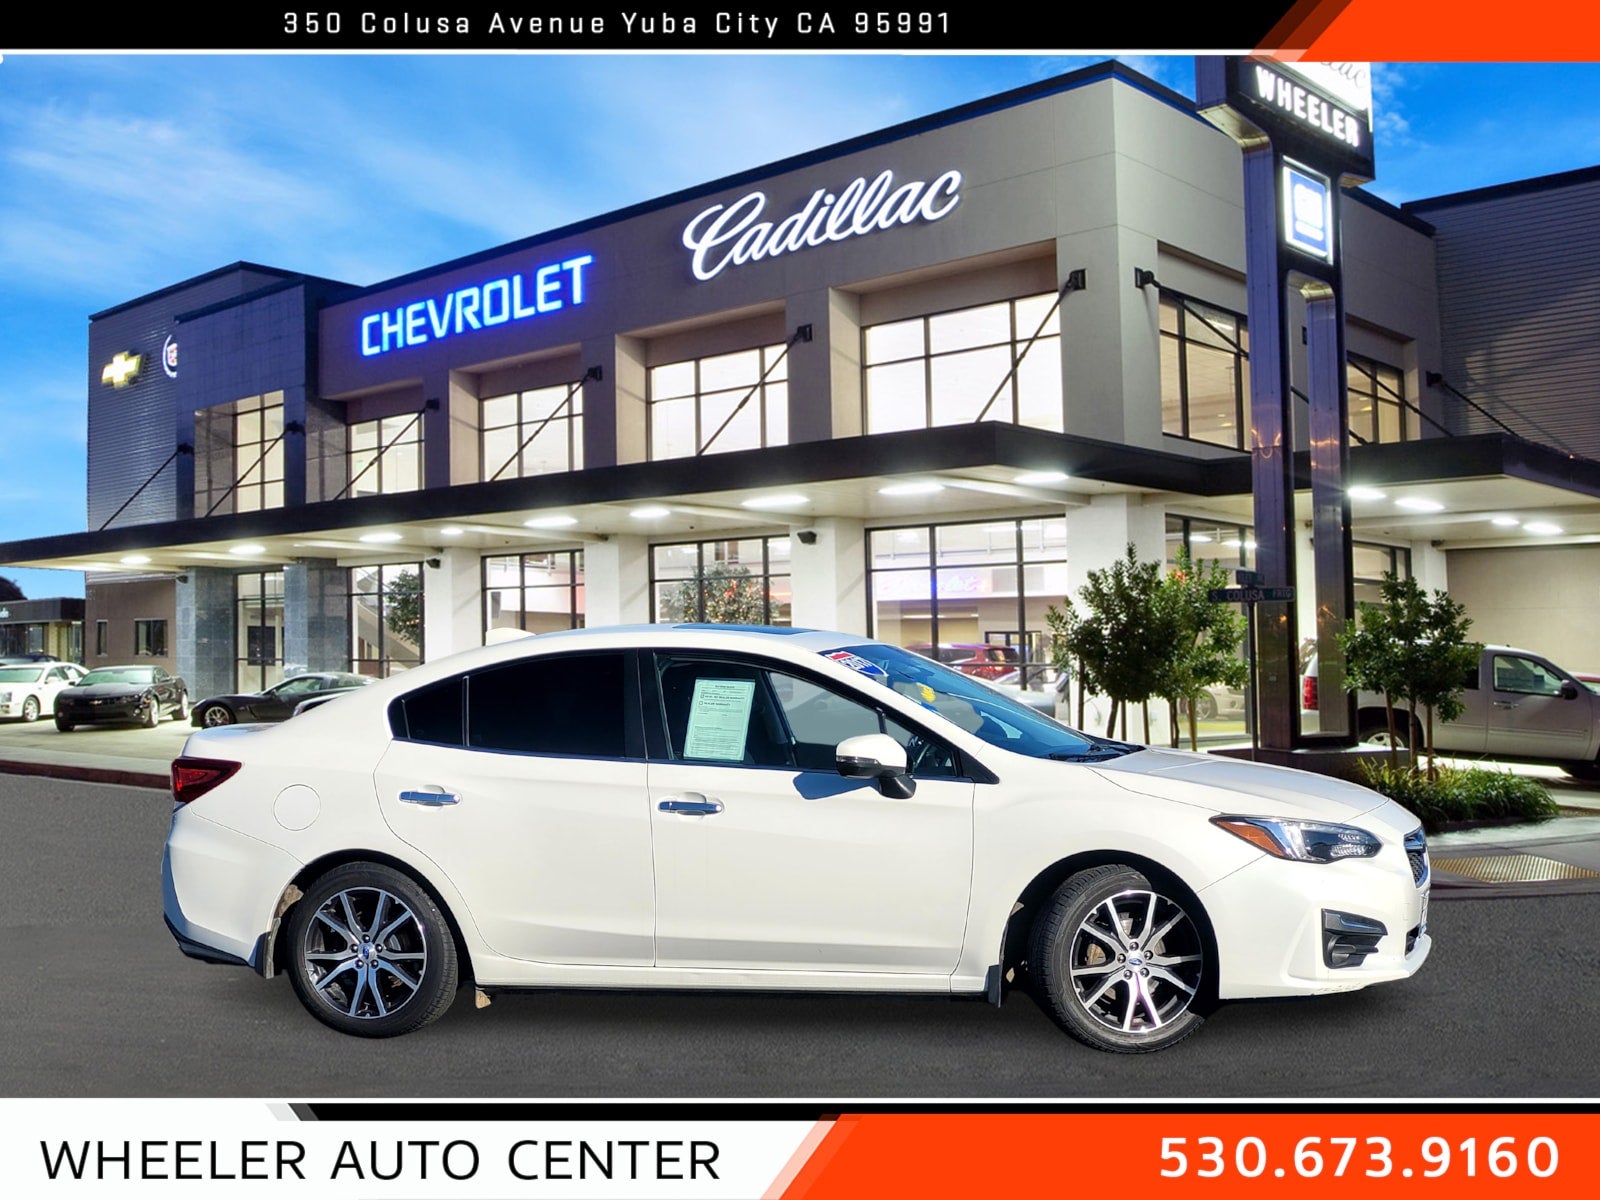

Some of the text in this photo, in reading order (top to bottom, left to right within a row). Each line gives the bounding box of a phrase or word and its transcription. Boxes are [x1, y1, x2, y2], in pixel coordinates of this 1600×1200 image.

[1255, 65, 1360, 148] WHEELER
[682, 169, 962, 281] Cadillac
[361, 254, 594, 357] CHEVROLET
[1226, 589, 1266, 601] COLUSA
